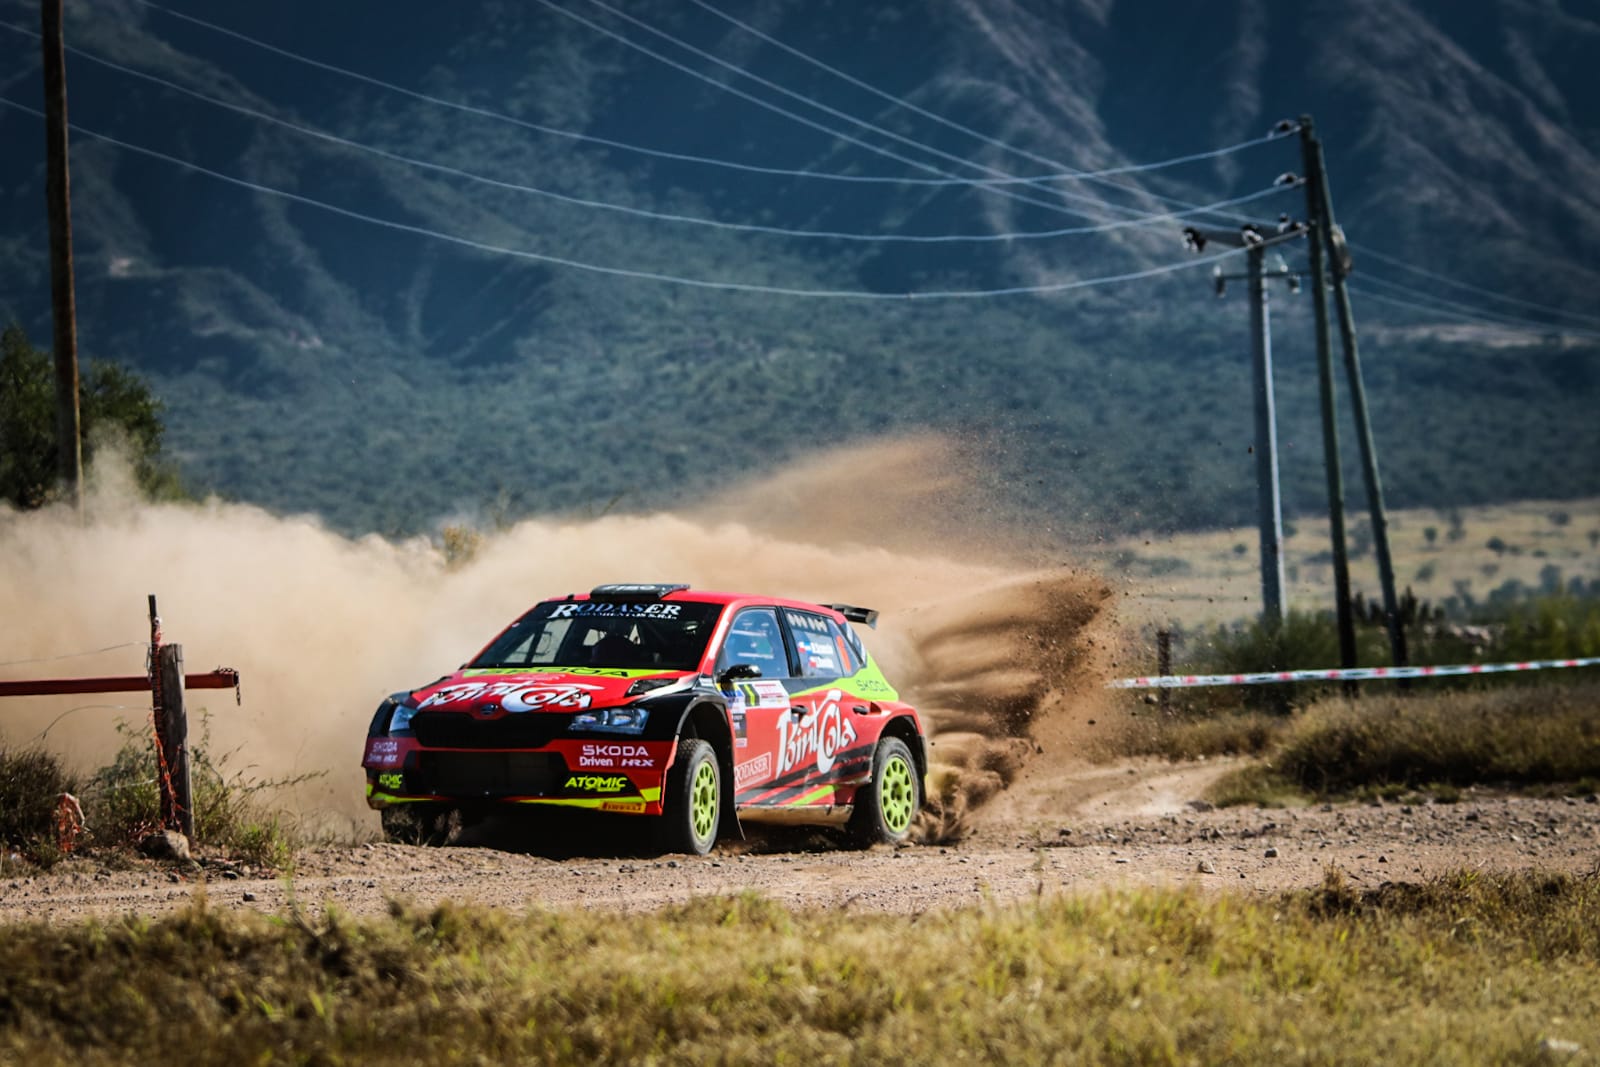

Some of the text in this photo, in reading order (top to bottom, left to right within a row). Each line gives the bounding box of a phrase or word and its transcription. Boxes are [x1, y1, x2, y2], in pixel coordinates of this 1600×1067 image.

[546, 603, 682, 619] RODASER
[579, 756, 654, 767] Driven HRX
[564, 775, 628, 790] ATOMIC
